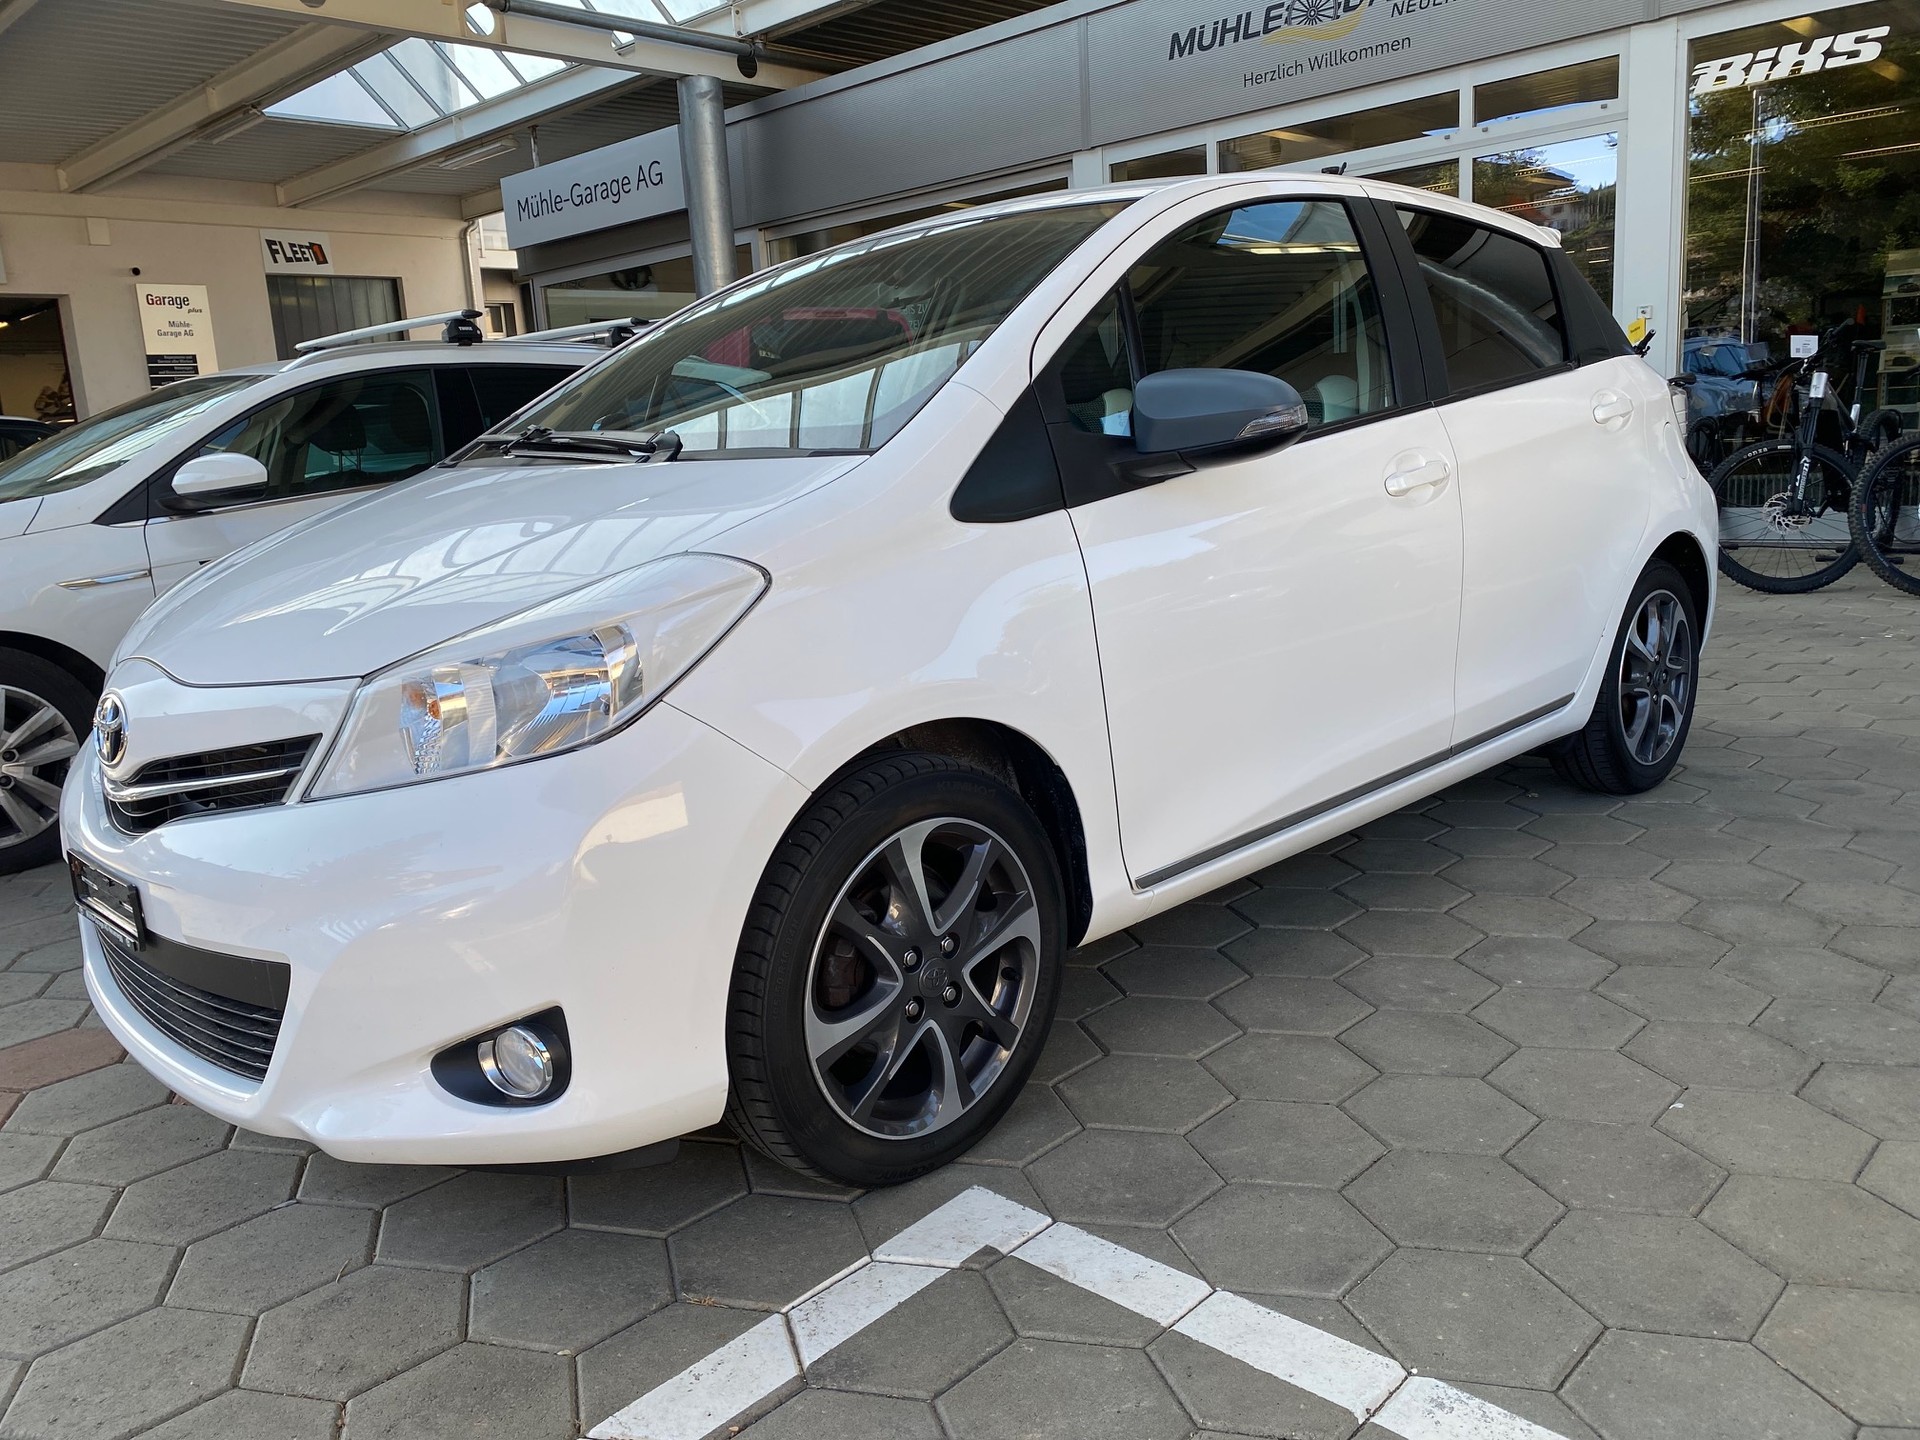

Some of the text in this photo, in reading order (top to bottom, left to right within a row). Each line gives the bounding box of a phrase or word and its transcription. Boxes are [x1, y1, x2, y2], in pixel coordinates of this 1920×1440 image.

[1168, 2, 1285, 60] MÜHLE
[1243, 36, 1411, 88] Herzlich Willkommen
[517, 160, 664, 222] Mühle-Garage AG
[146, 293, 190, 309] Garage
[157, 329, 194, 338] Garage AG
[168, 320, 193, 328] Mühle-
